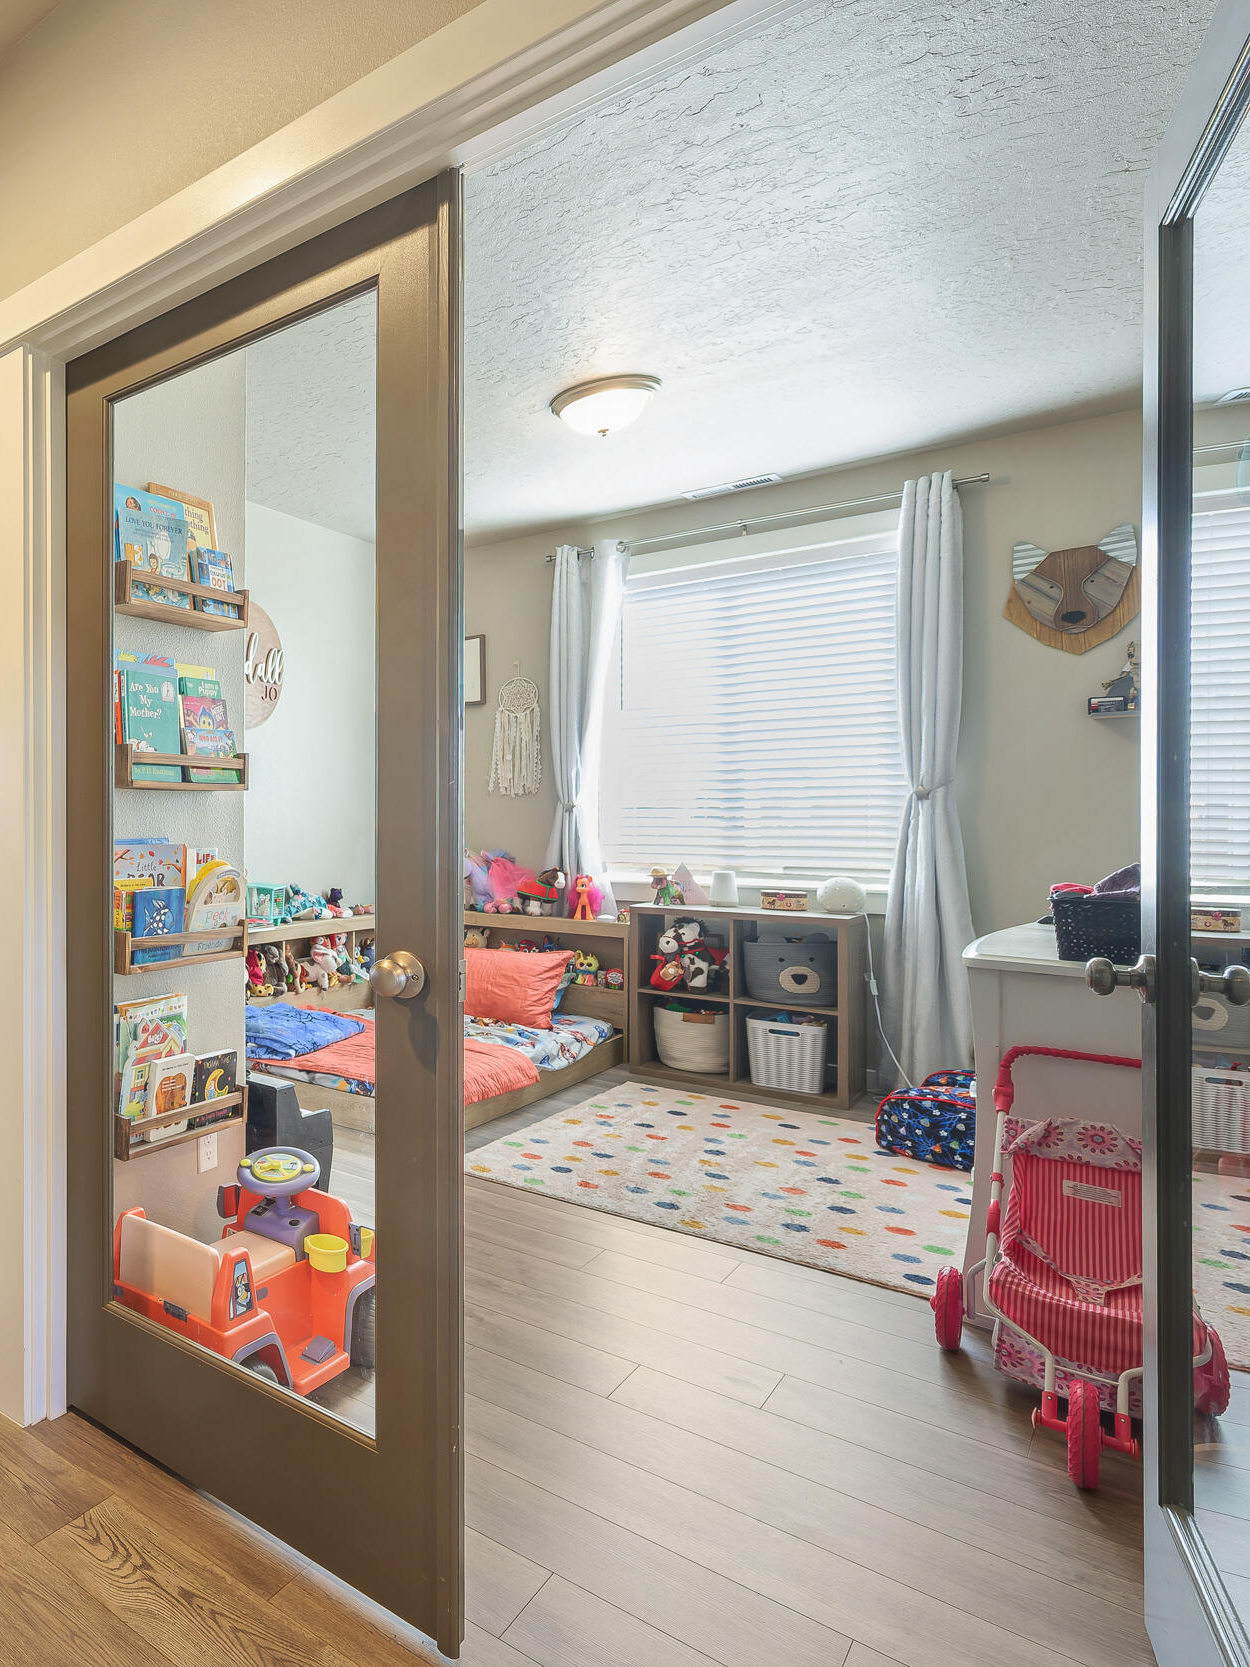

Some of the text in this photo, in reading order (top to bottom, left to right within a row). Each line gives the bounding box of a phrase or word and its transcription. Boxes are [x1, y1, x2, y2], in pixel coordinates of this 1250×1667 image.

[125, 515, 141, 527] LOVE
[142, 520, 155, 529] YOU
[156, 523, 183, 535] FOREVER
[190, 520, 209, 535] thing
[129, 682, 144, 692] Are
[145, 684, 159, 694] You
[198, 686, 219, 697] Puppy
[261, 686, 278, 702] JO
[140, 694, 153, 707] My
[130, 706, 162, 720] Mother?
[136, 861, 157, 872] Little
[205, 907, 229, 923] Peek
[197, 940, 223, 951] Friends
